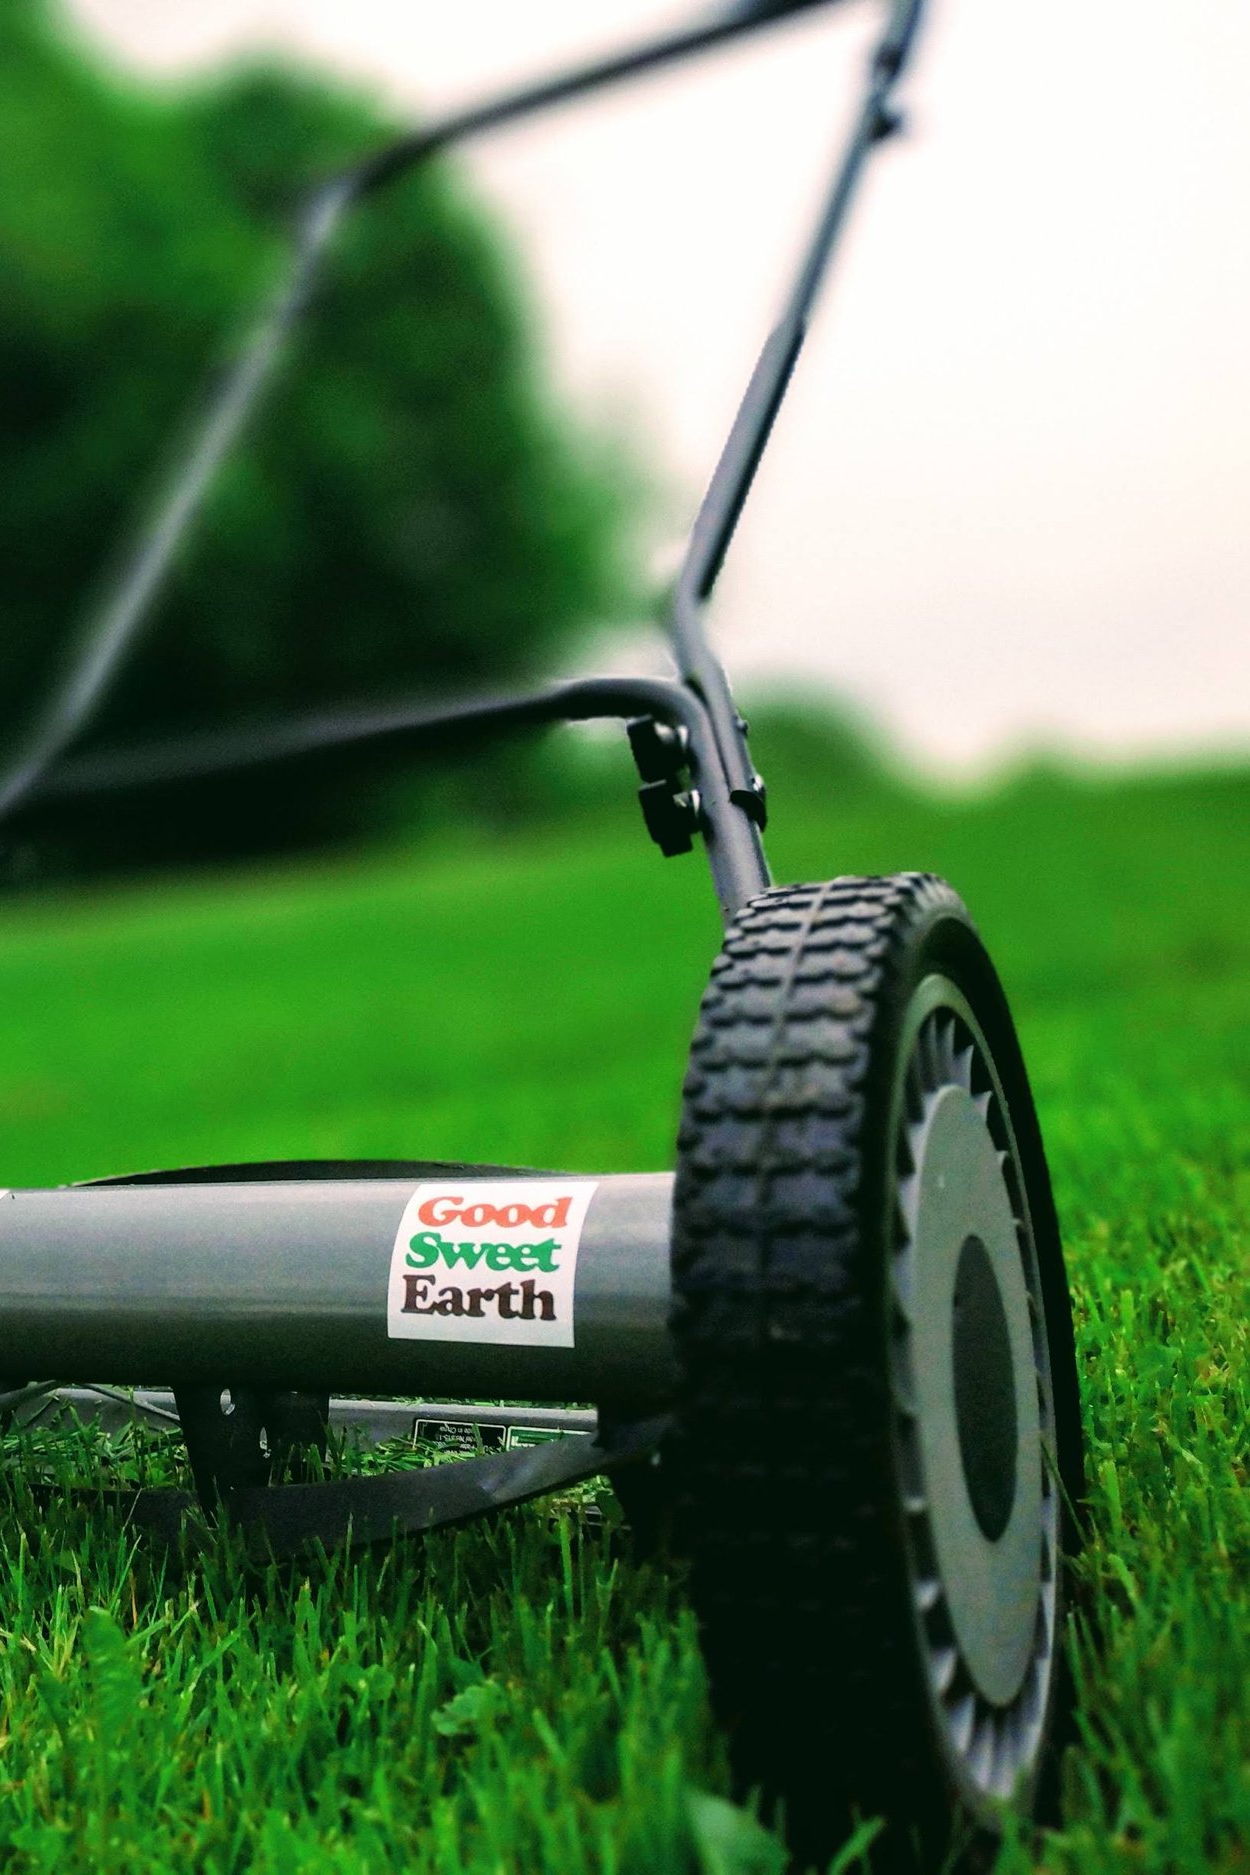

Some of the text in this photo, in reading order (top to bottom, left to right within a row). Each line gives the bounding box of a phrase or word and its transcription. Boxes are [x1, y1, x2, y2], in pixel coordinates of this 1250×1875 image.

[418, 1196, 573, 1228] Good
[405, 1231, 562, 1273] Sweet
[401, 1274, 557, 1321] Earth
